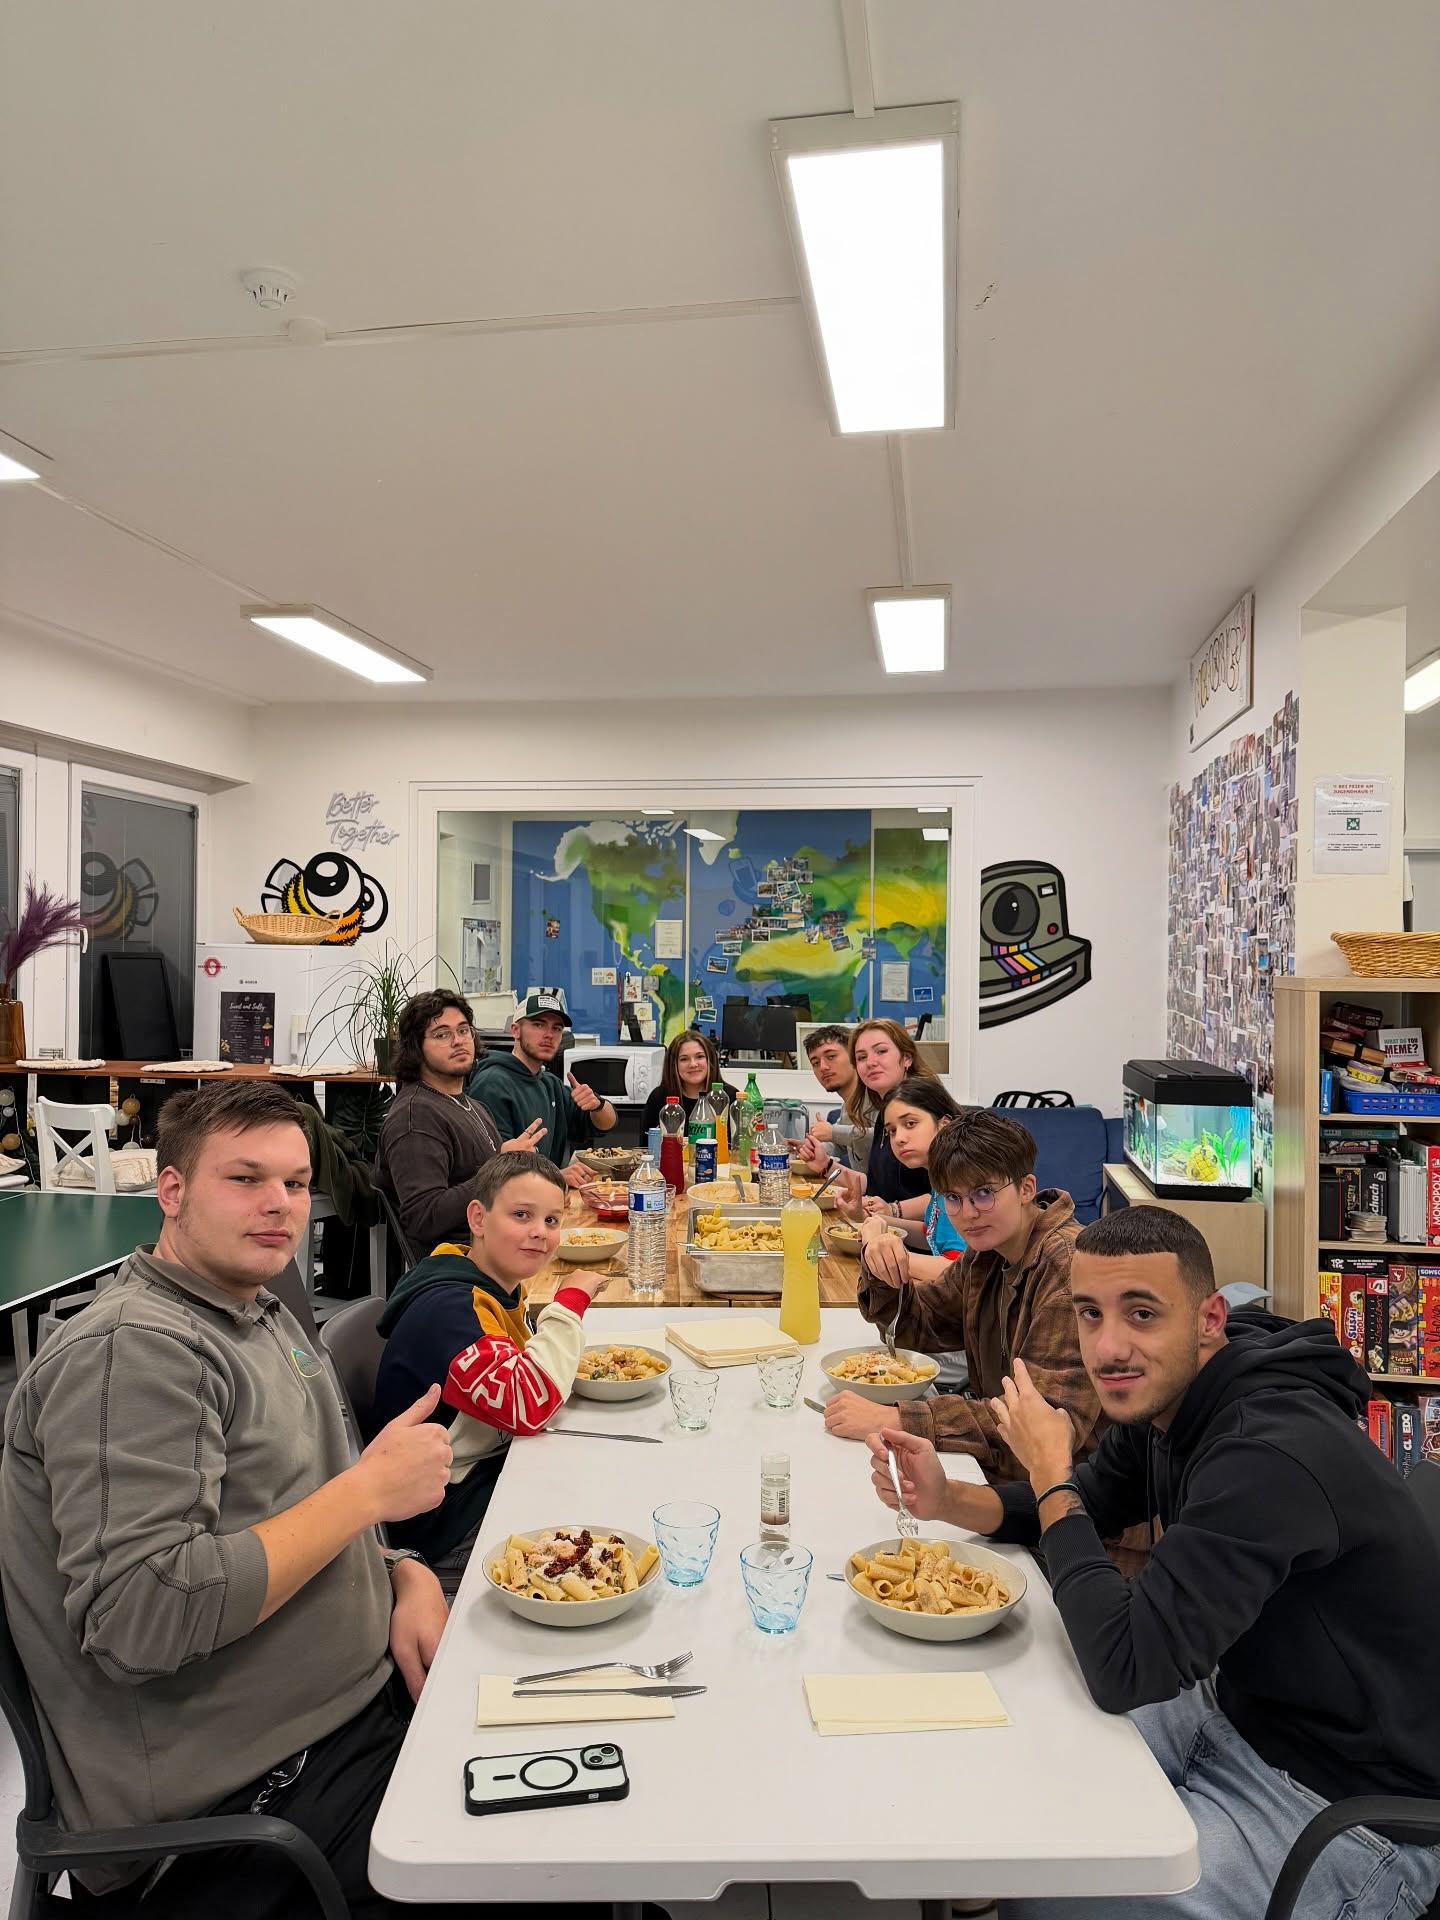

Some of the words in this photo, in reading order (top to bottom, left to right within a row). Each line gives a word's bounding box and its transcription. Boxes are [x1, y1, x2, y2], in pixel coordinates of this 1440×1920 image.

[325, 791, 380, 819] Better
[325, 818, 400, 852] Together
[1384, 1044, 1419, 1055] MEME?
[1369, 1183, 1380, 1217] chach
[1432, 1171, 1440, 1226] MONOPOLY
[1401, 1413, 1412, 1451] CLUEDO
